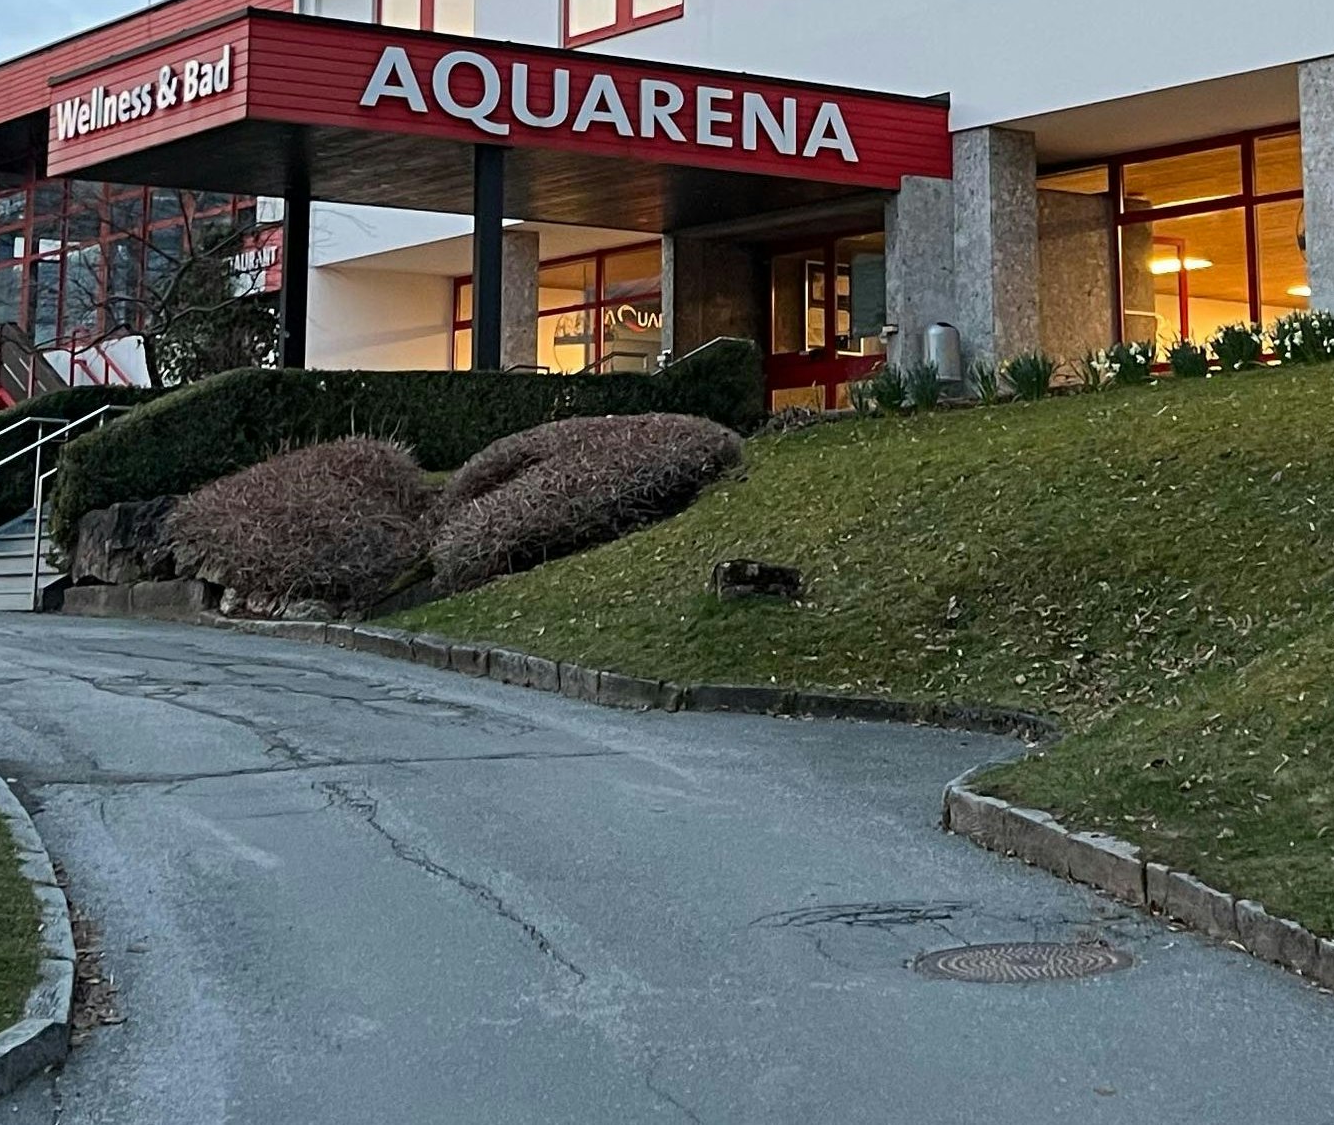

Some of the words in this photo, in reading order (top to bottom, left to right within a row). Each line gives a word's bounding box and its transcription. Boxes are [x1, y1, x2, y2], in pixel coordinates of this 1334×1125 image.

[56, 85, 152, 141] Wellness
[156, 65, 178, 110] &
[183, 44, 231, 103] Bad
[360, 46, 859, 163] AQUARENA
